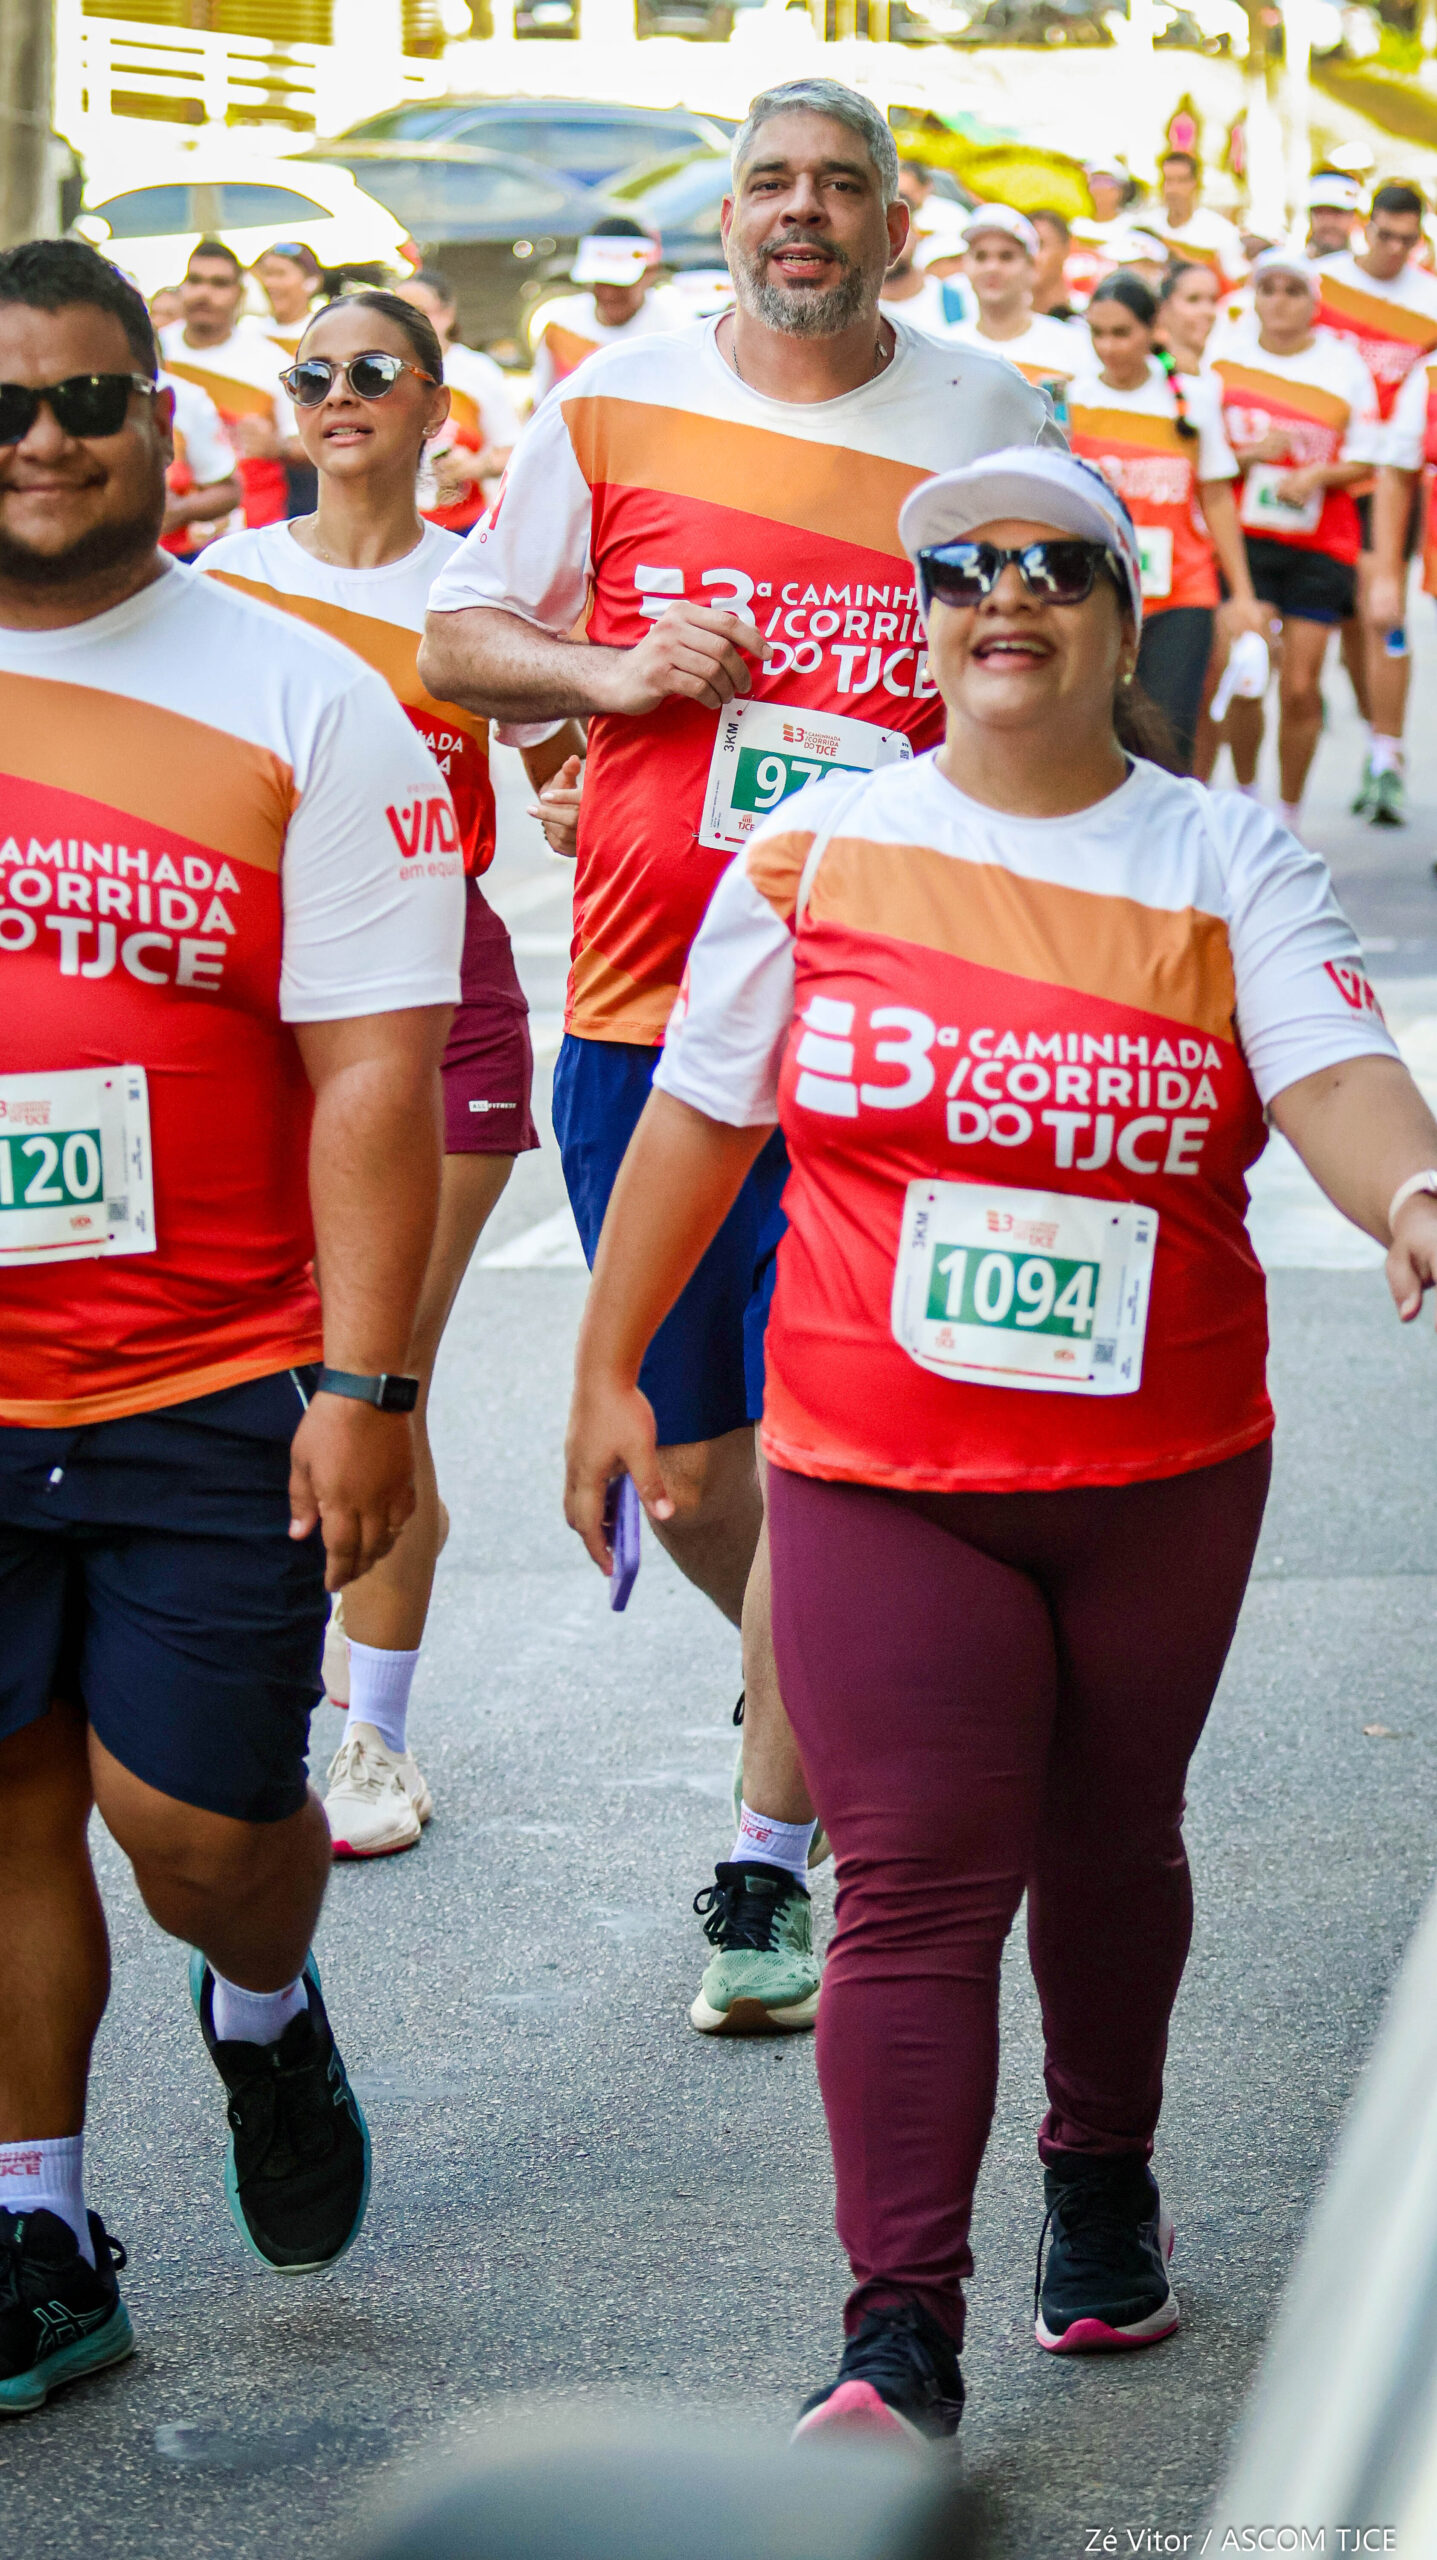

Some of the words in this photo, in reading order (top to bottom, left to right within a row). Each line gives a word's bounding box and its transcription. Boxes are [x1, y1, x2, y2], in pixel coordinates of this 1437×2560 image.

[781, 582, 919, 611] CAMINH
[762, 641, 823, 675] DO
[830, 643, 939, 698] TJCE
[418, 730, 463, 753] ADA
[723, 722, 739, 752] 3KM
[804, 742, 815, 750] DO
[815, 744, 837, 757] TJCE
[754, 756, 848, 808] 97
[0, 836, 241, 894] AMINHADA
[0, 867, 237, 935] ORRIDA
[45, 914, 227, 991] TJCE
[969, 1028, 1222, 1069] CAMINHADA
[945, 1057, 1219, 1110] /CORRIDA
[946, 1101, 1033, 1146] DO
[1042, 1110, 1210, 1175] TJCE
[912, 1211, 929, 1249] 3KM
[936, 1249, 1094, 1333] 1094
[0, 2163, 40, 2176] JCE
